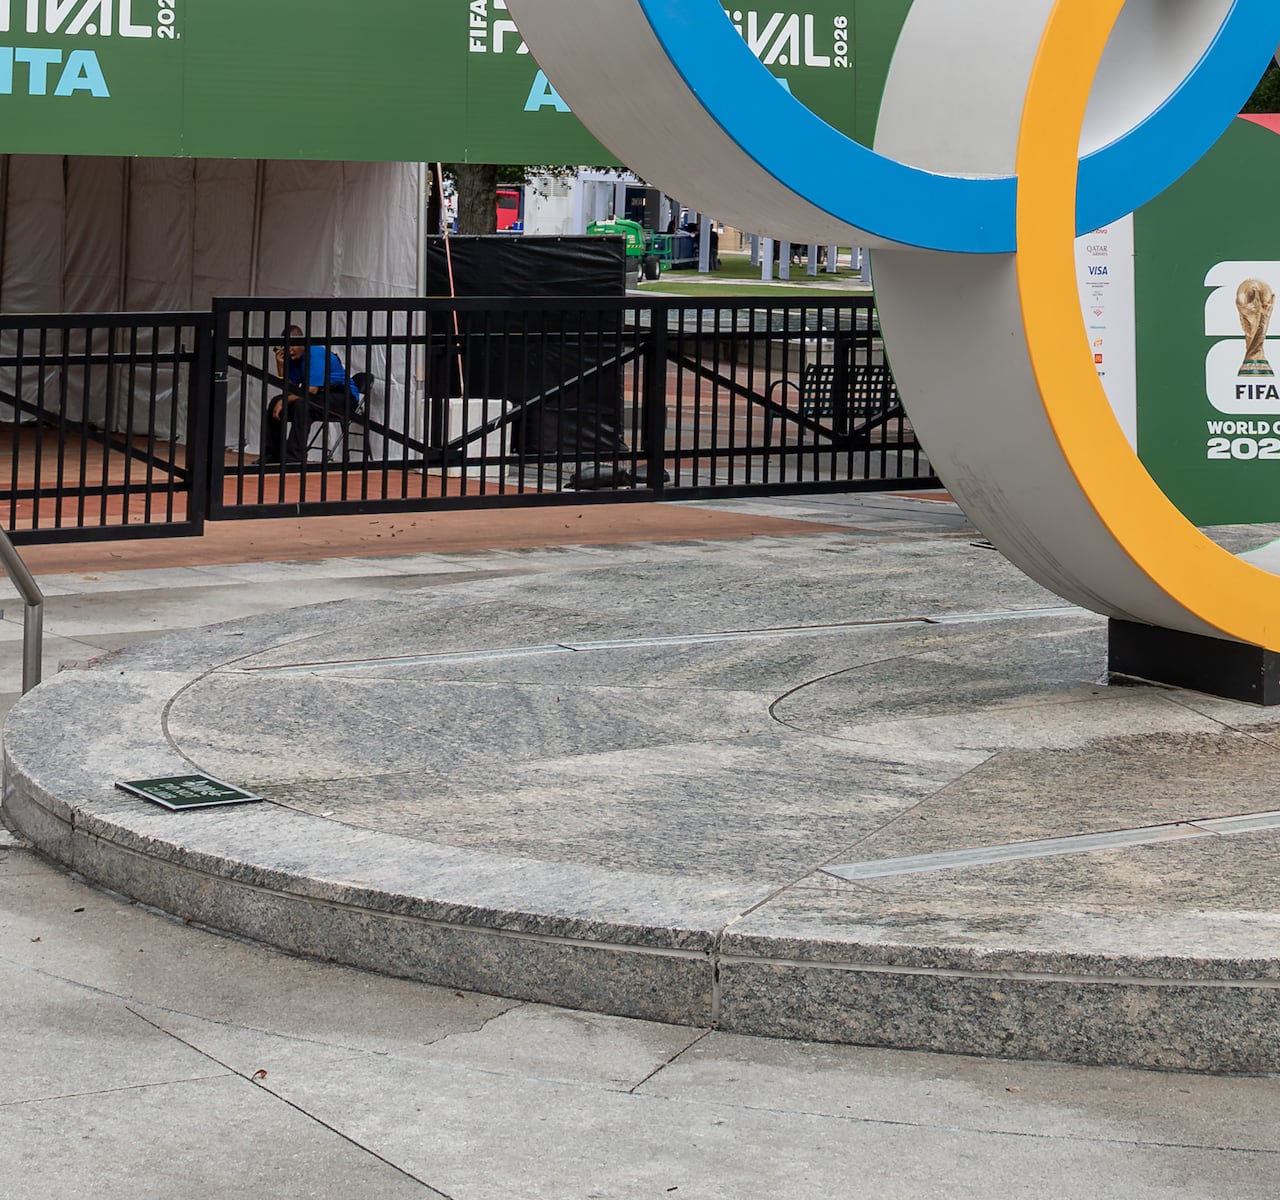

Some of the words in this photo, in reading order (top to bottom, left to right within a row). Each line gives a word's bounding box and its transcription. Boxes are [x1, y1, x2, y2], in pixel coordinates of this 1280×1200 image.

[833, 15, 848, 68] 2026
[1087, 265, 1108, 276] VISA
[1235, 384, 1280, 400] FIFA
[1206, 420, 1271, 435] WORLD
